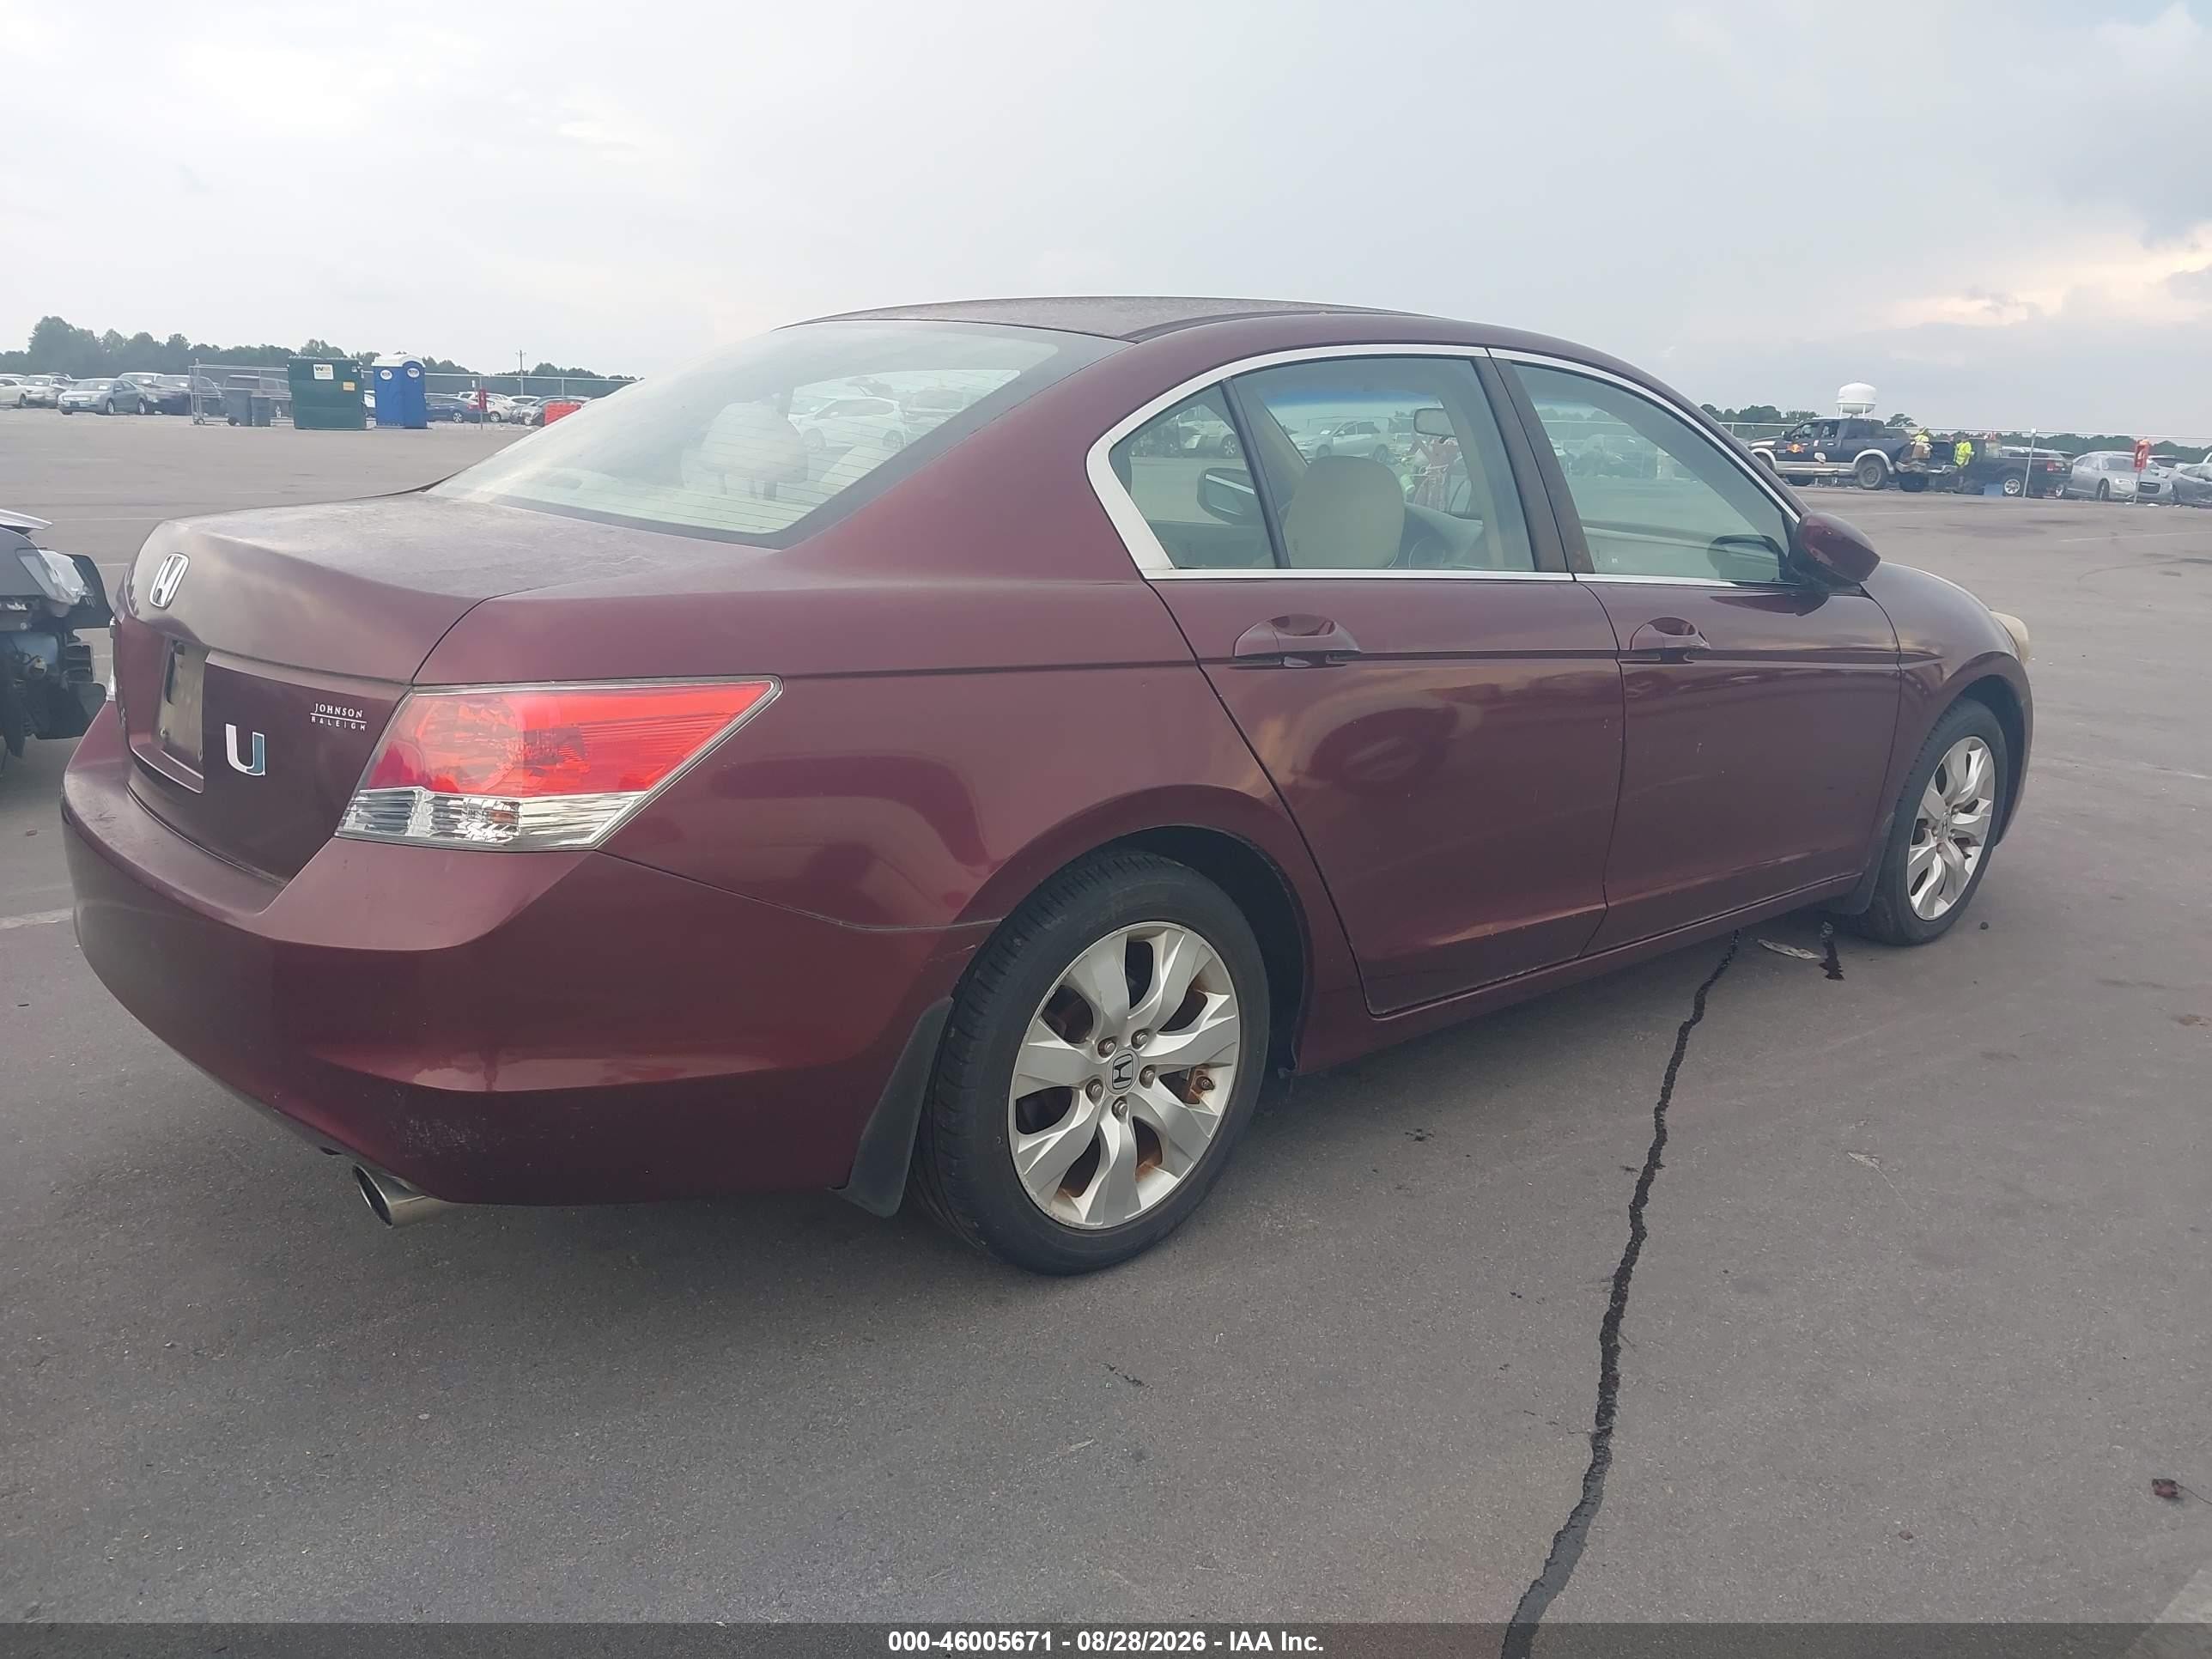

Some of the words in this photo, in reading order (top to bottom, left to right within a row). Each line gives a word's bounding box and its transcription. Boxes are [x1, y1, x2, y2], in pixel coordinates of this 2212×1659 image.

[314, 702, 363, 719] JOHNSON
[311, 715, 367, 732] RALEIGH
[225, 723, 265, 776] U
